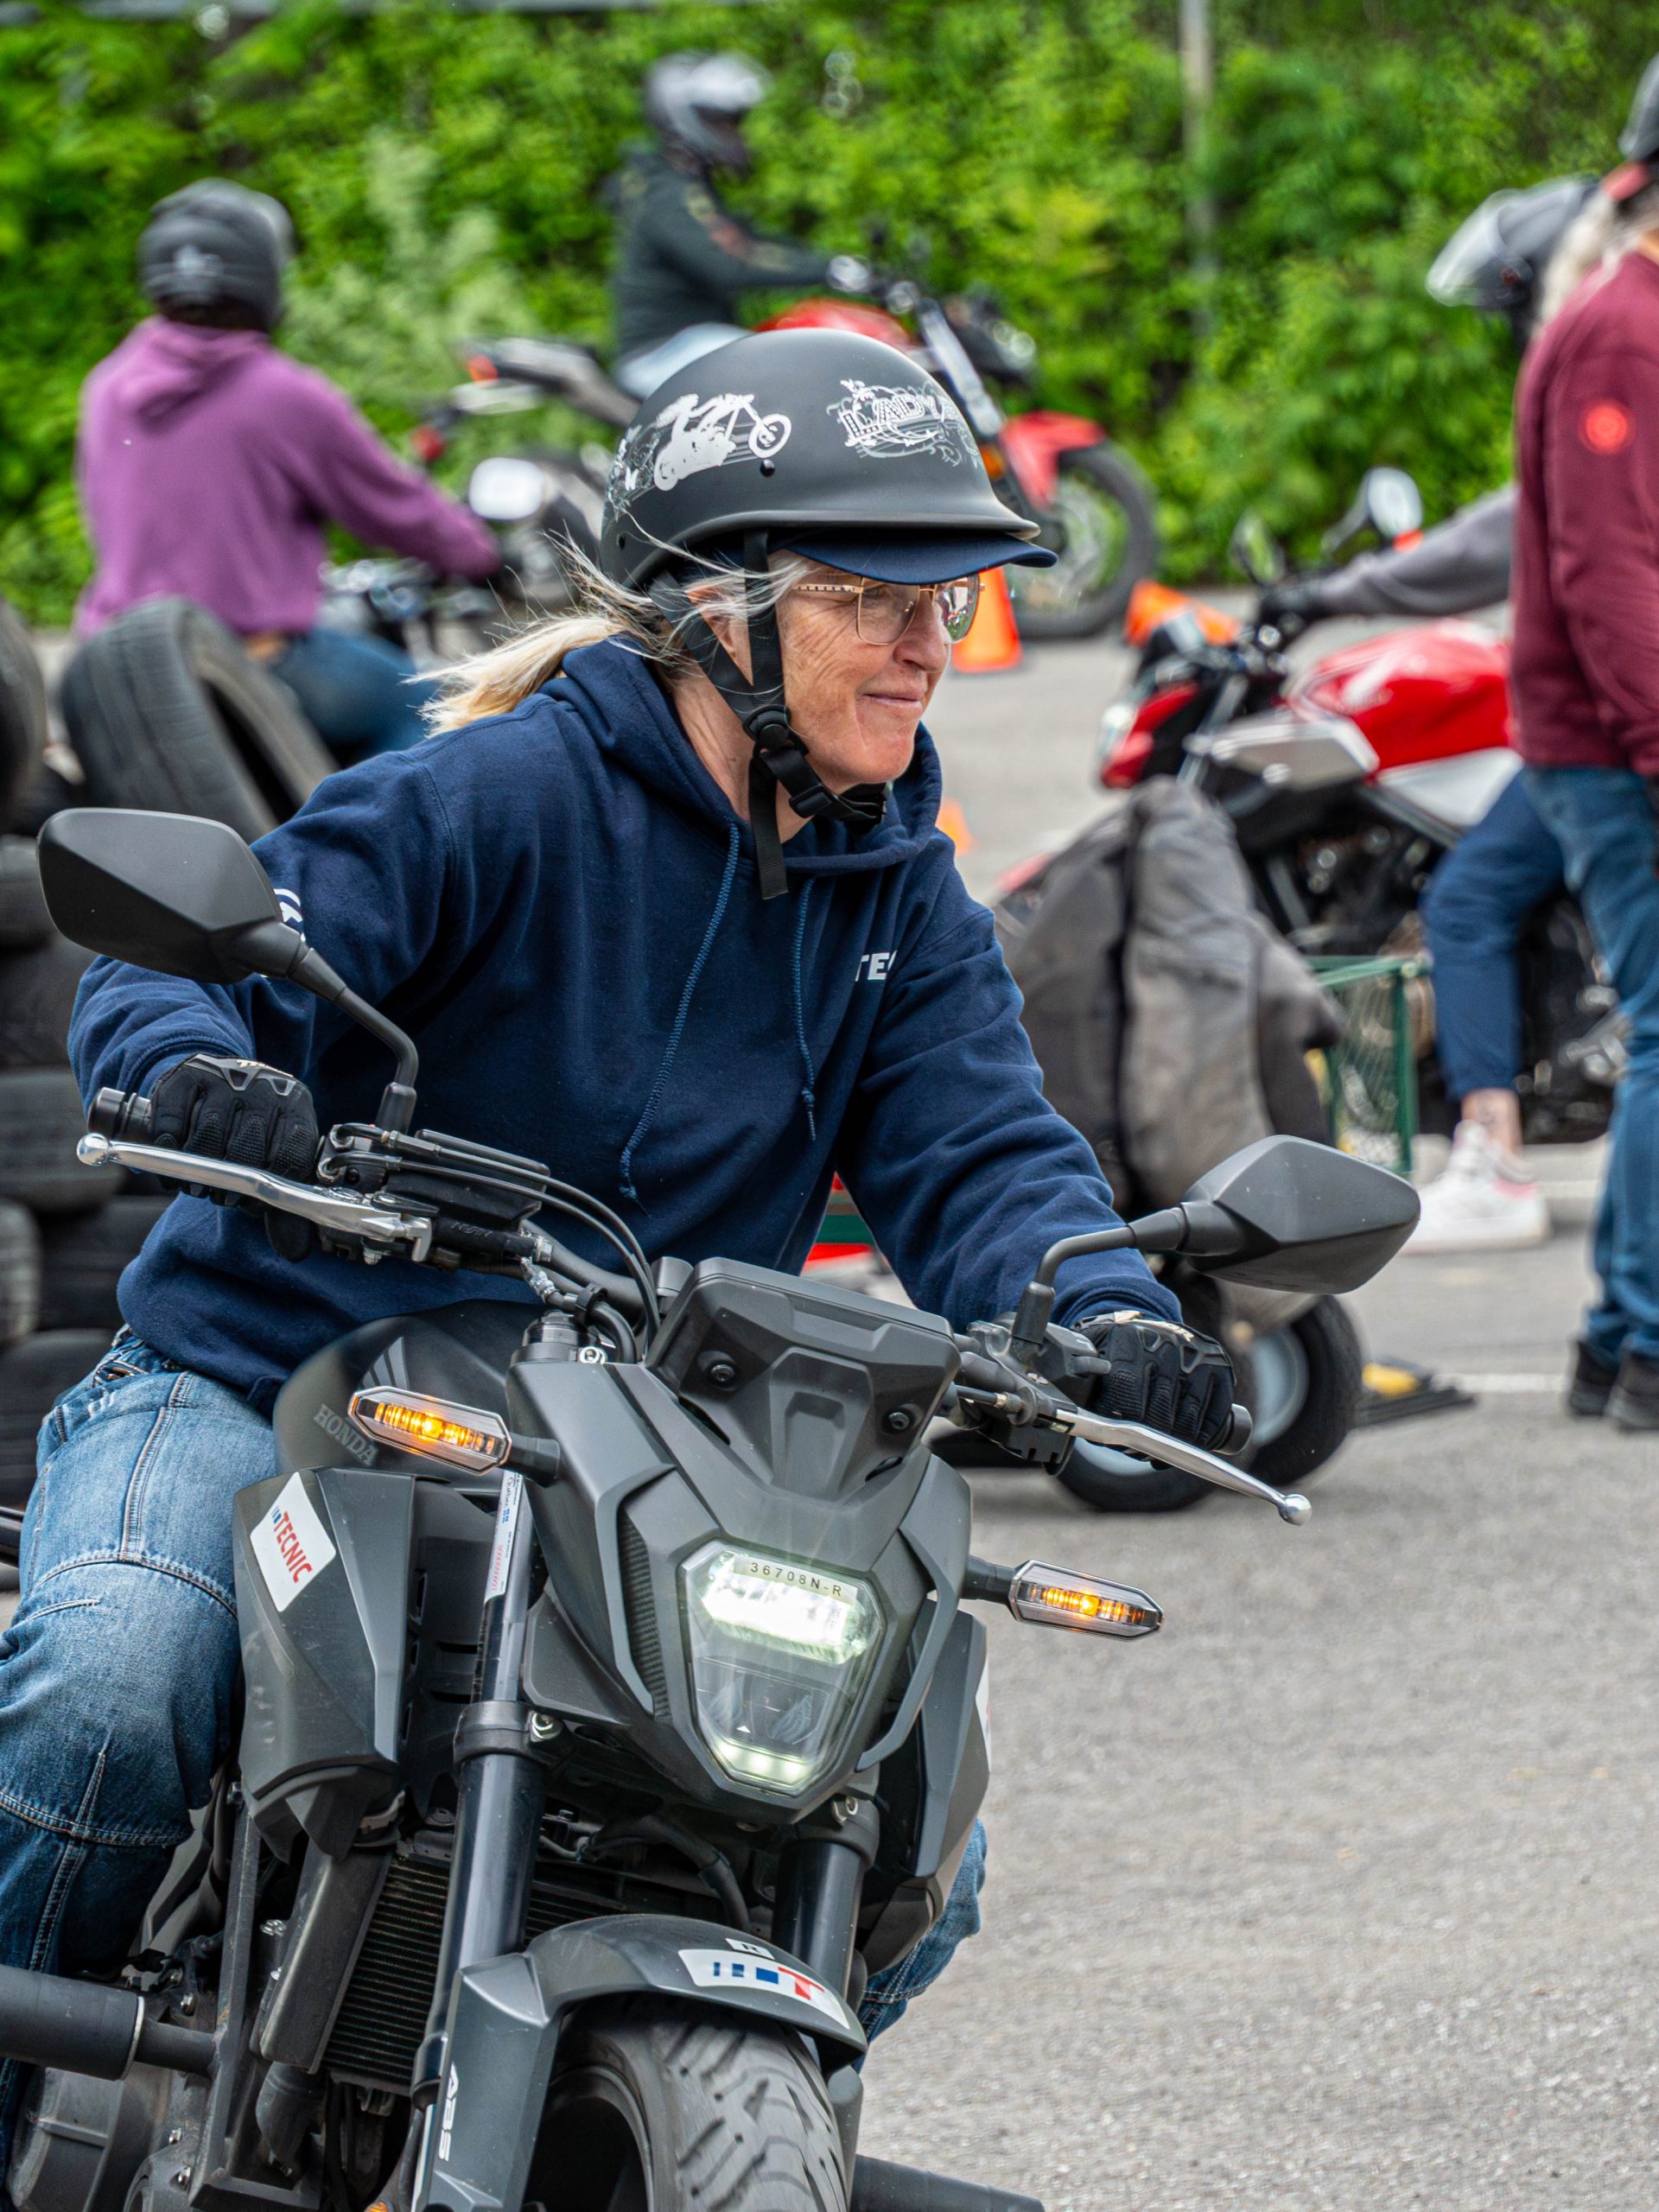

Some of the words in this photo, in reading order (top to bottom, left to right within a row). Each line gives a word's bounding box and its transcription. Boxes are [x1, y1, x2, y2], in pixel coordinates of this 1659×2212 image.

[313, 1403, 378, 1466] HONDA
[274, 1510, 313, 1583] TECNIC
[750, 1562, 842, 1597] 36708N-R
[439, 2061, 459, 2162] ABS
